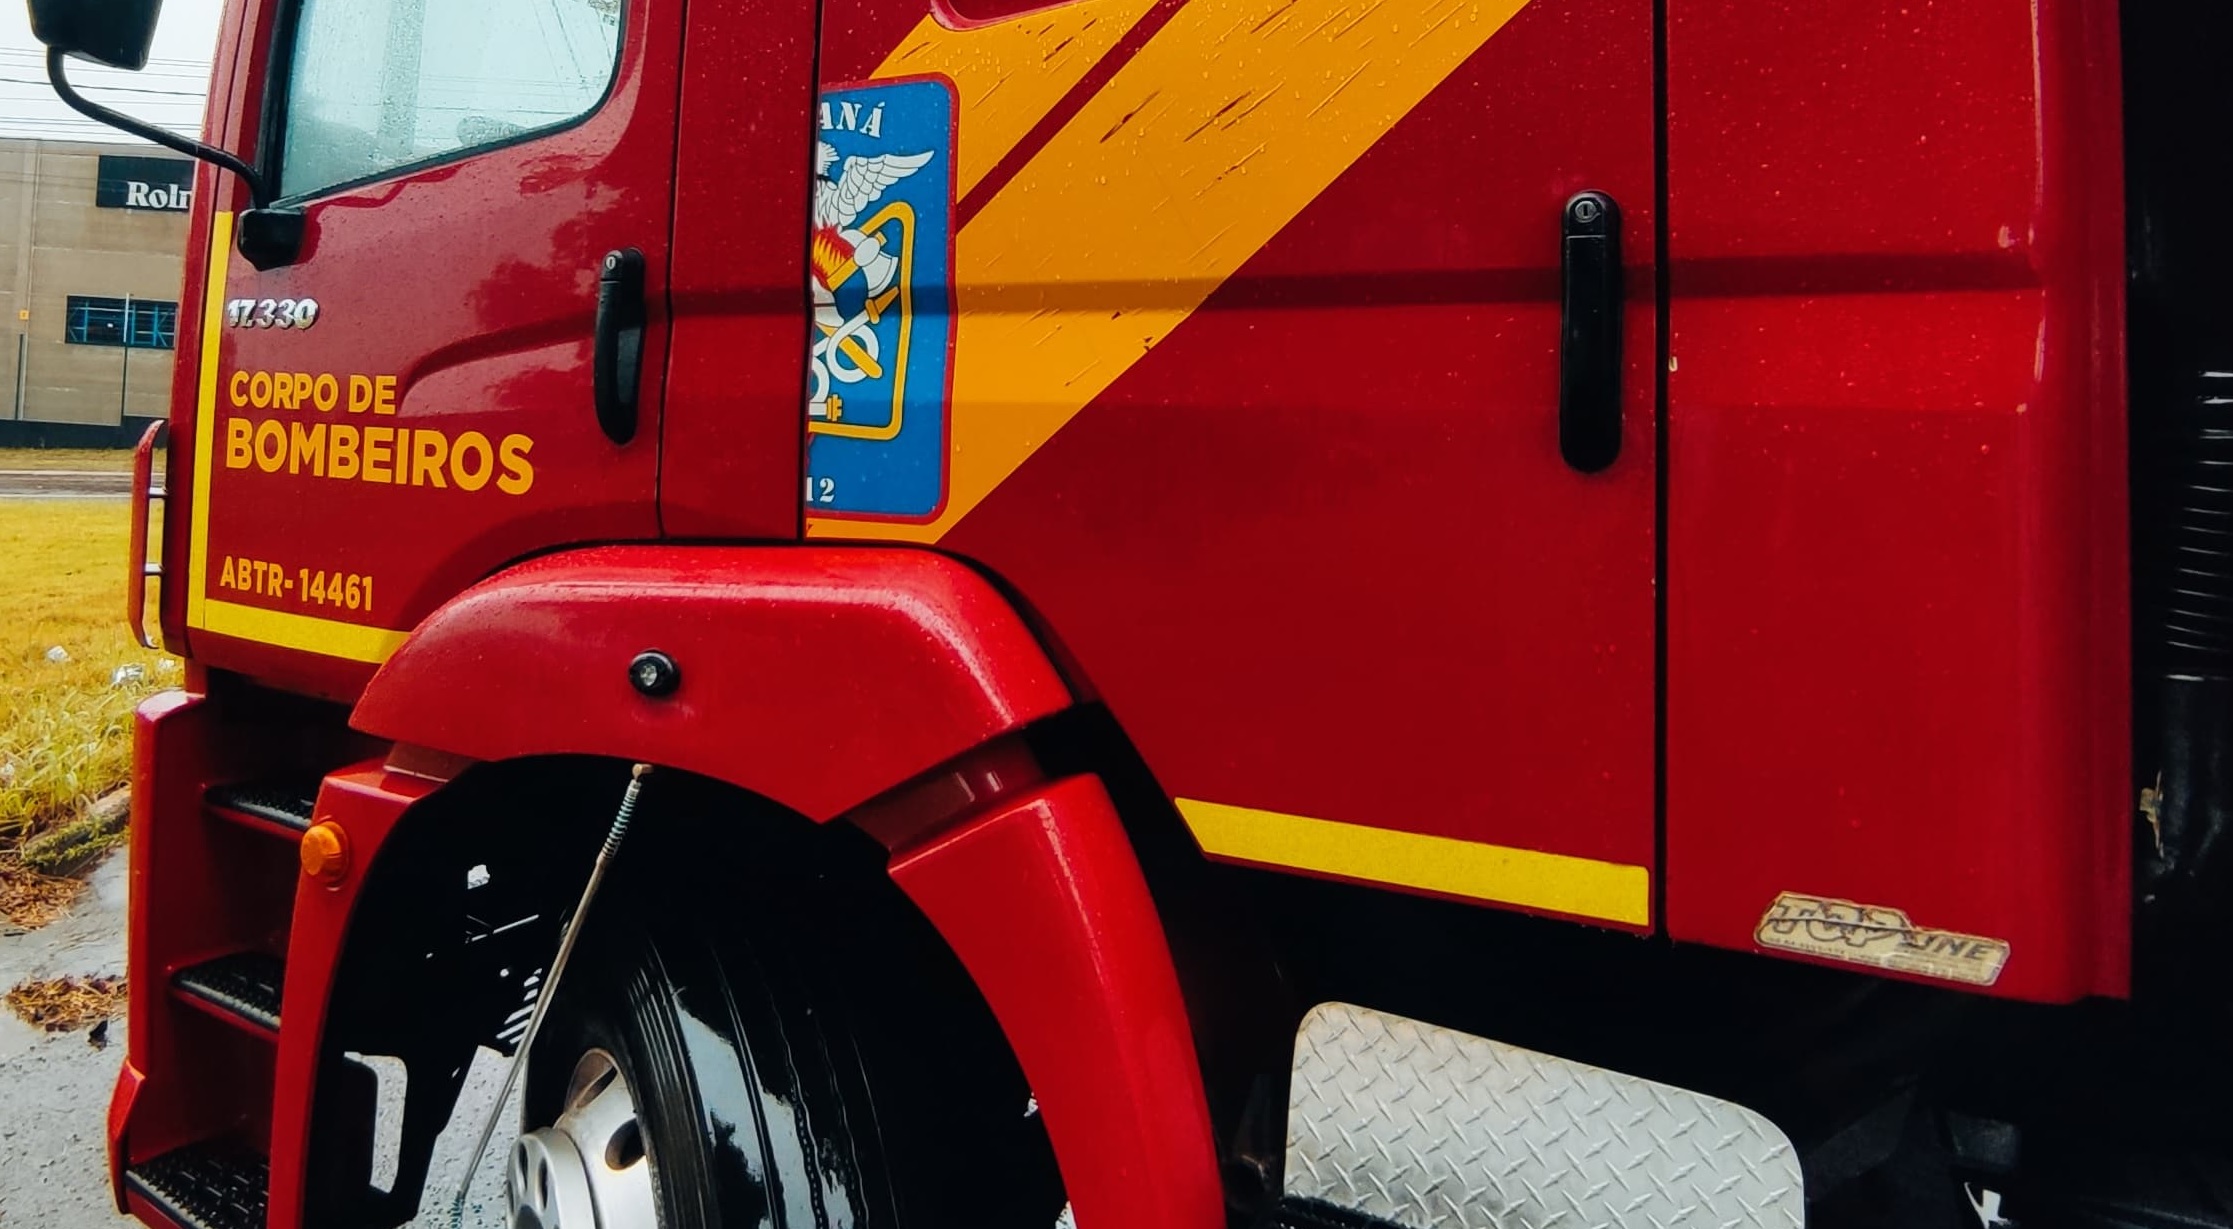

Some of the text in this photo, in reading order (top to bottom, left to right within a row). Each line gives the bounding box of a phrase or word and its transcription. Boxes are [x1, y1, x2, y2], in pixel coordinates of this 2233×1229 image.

[229, 370, 397, 415] CORPO DE
[225, 417, 535, 495] BOMBEIROS
[299, 568, 373, 612] 14461
